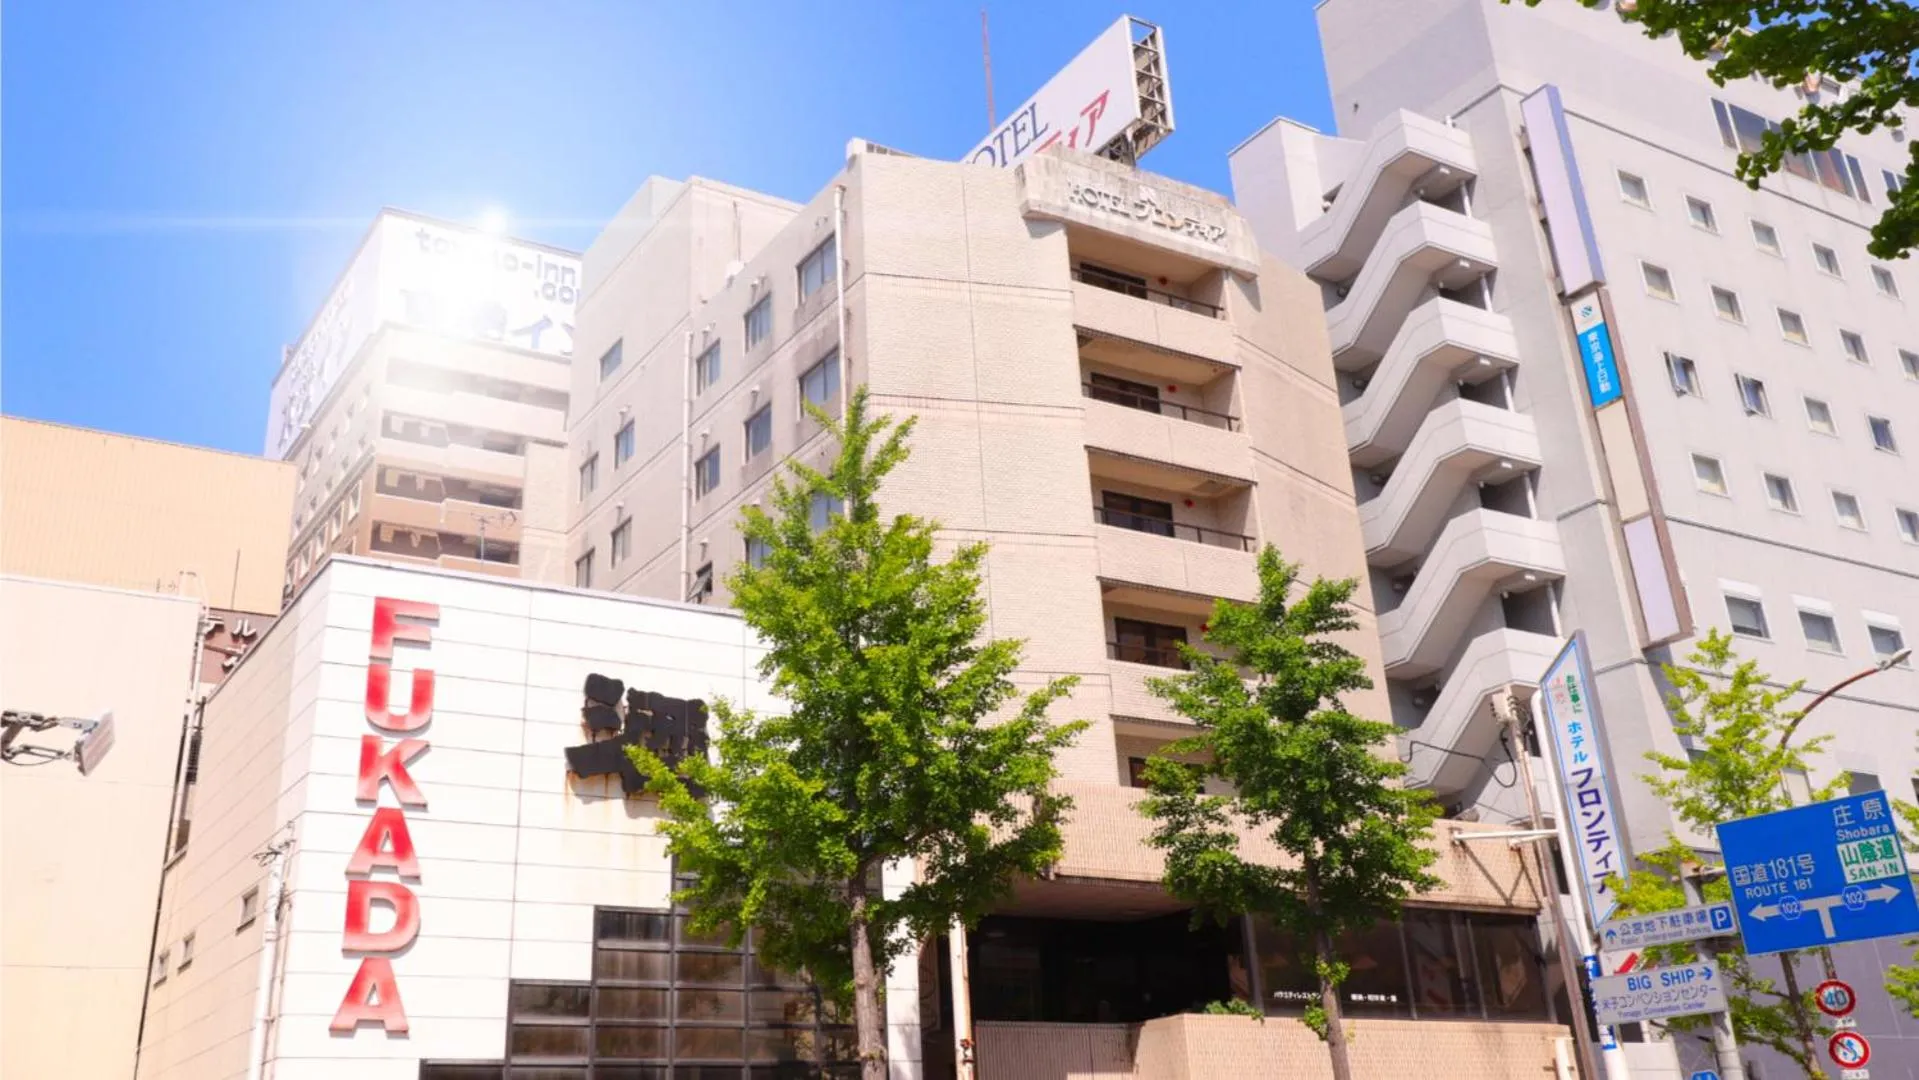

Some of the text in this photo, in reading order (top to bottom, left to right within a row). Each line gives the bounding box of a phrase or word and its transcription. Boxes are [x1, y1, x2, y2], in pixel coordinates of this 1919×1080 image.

[967, 102, 1049, 168] OTEL
[1068, 179, 1131, 218] HOTEL
[329, 595, 440, 1038] FUKADA
[1836, 823, 1890, 842] Shobara
[1841, 835, 1898, 867] 山陰道
[1732, 853, 1815, 887] 国道181号
[1850, 861, 1899, 881] SAN-IN
[1744, 878, 1813, 899] ROUTE 181
[1846, 890, 1862, 904] 102
[1782, 901, 1798, 914] 102
[1627, 968, 1696, 991] BIG SHIP
[1824, 990, 1847, 1006] 40
